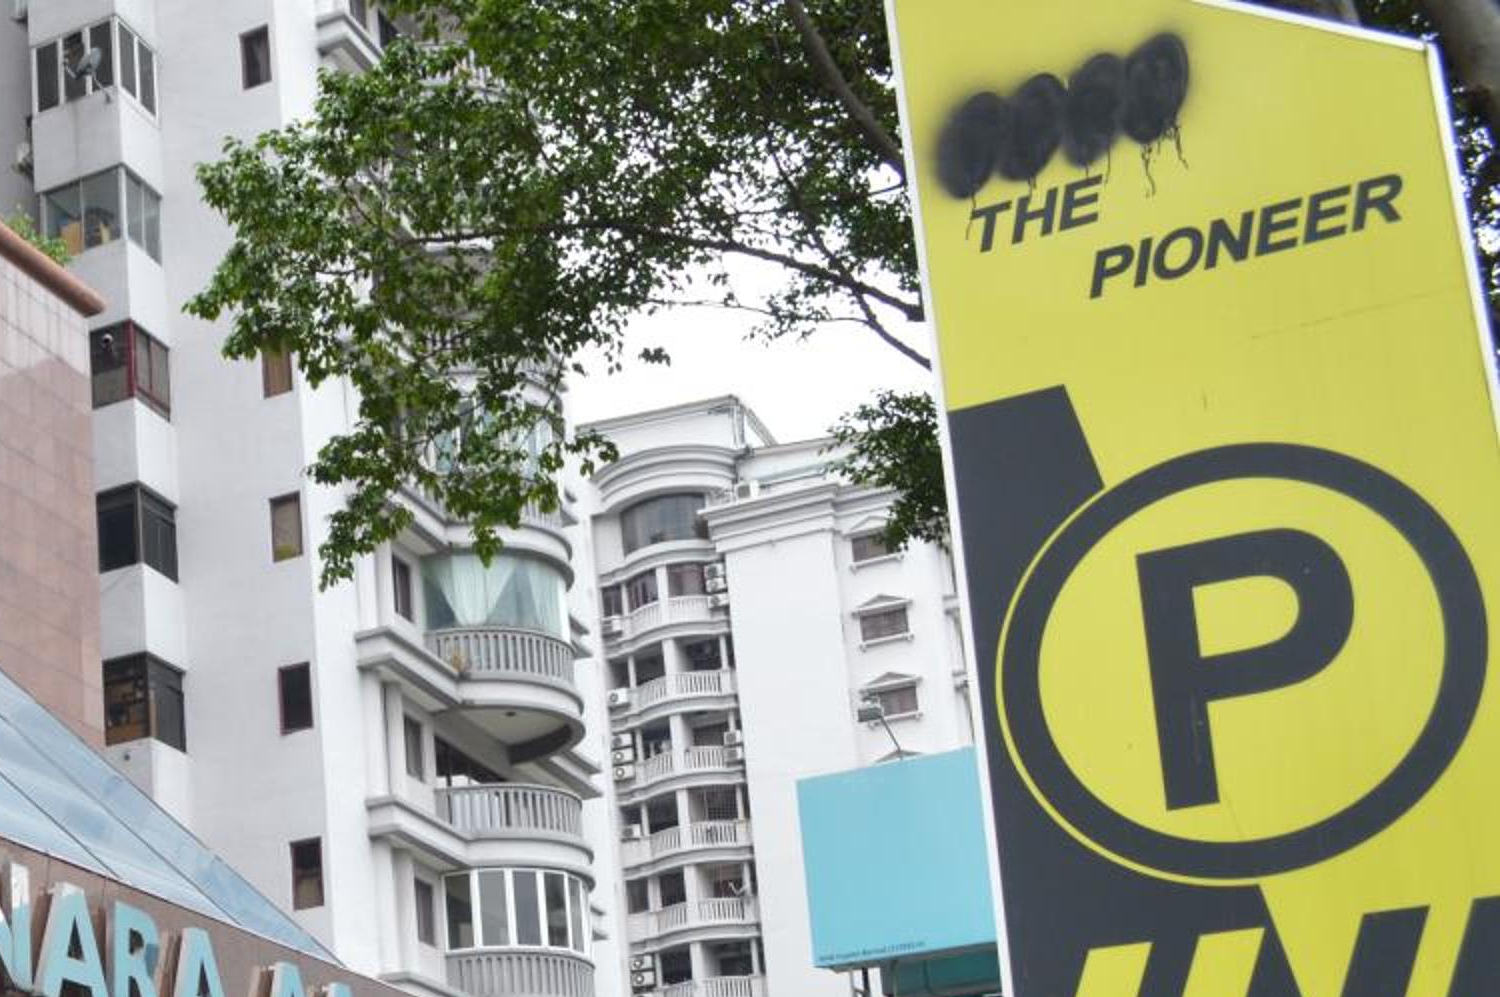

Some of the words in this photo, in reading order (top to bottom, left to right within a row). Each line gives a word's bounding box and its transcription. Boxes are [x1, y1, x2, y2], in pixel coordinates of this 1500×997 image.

[971, 174, 1103, 253] THE
[1089, 173, 1403, 299] PIONEER
[1135, 527, 1355, 811] P
